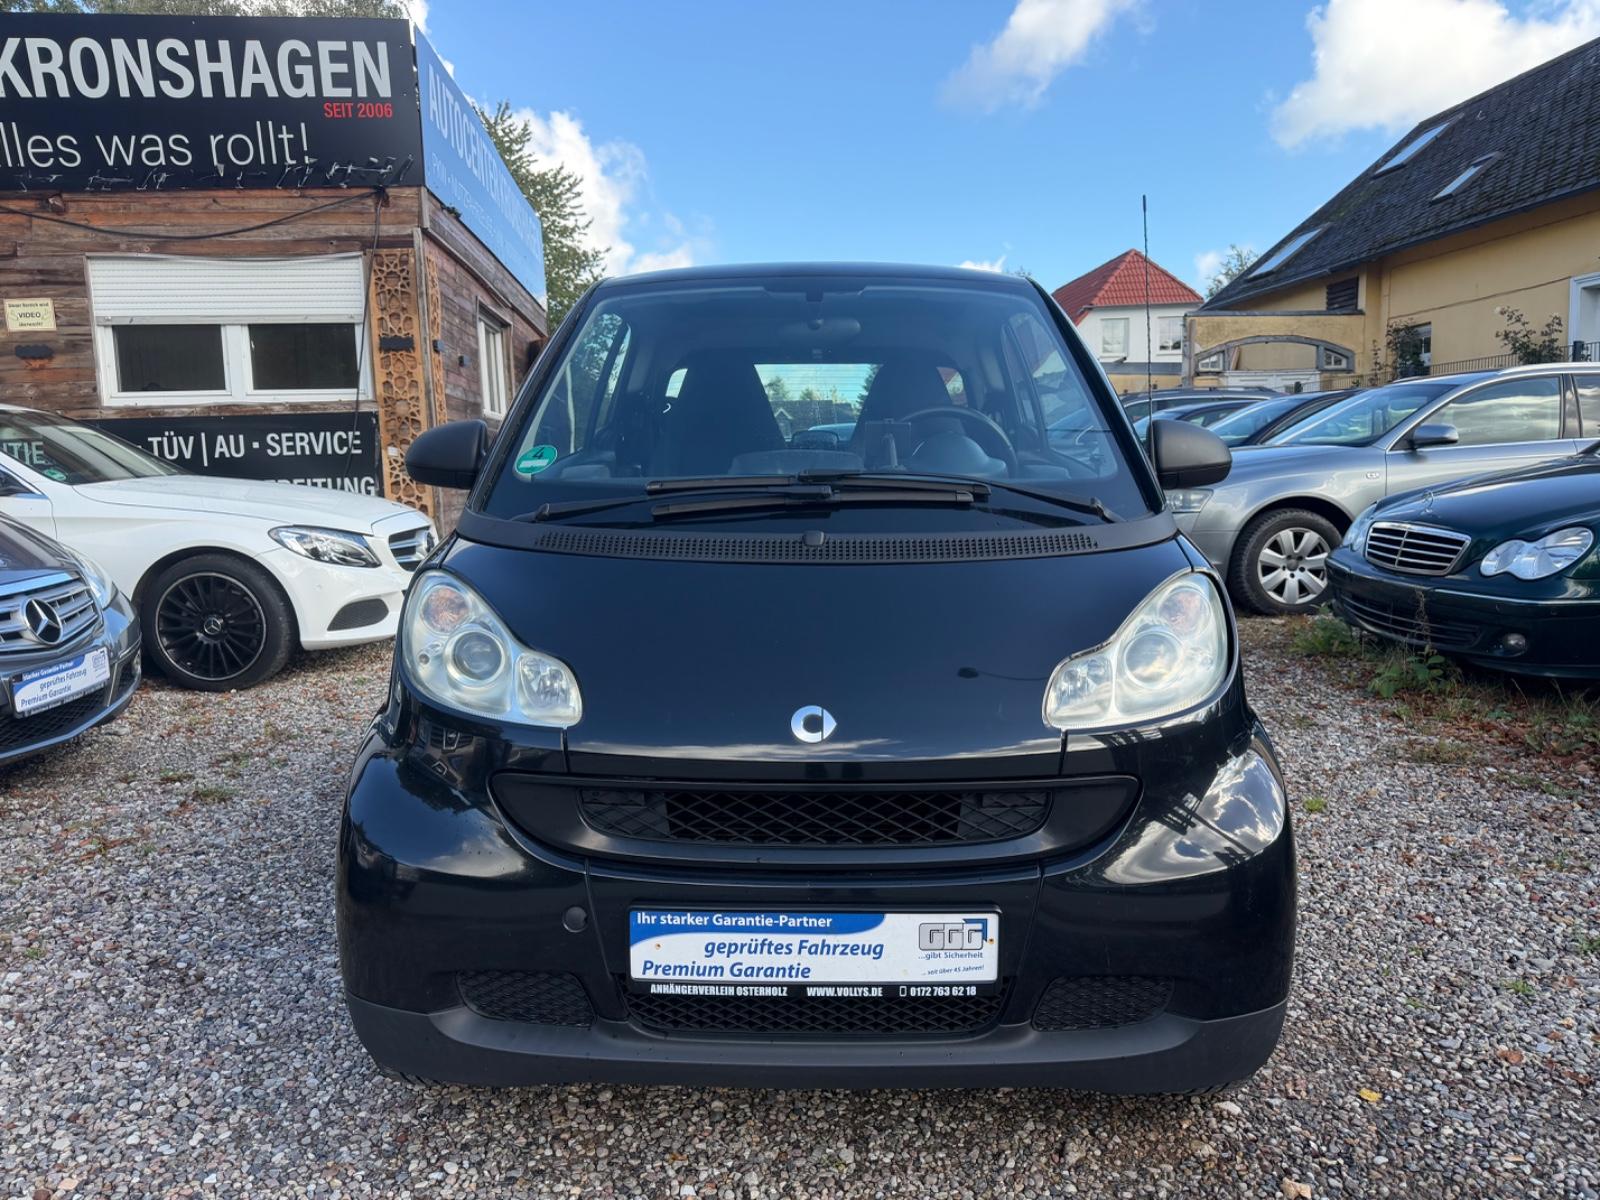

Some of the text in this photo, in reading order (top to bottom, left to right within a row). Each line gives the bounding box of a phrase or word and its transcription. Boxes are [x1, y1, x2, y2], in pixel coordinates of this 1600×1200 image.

[0, 37, 392, 99] KRONSHAGEN
[323, 102, 393, 118] SEIT 2006
[0, 120, 310, 169] lles was rollt!
[18, 311, 41, 319] VIDEO
[148, 431, 194, 460] TÜV
[214, 434, 246, 459] AU
[266, 430, 362, 457] SERVICE
[532, 447, 545, 459] 4
[20, 693, 48, 708] Premium
[637, 912, 832, 928] Ihr starker Garantie-Partner
[704, 938, 884, 960] geprüftes Fahrzeug
[944, 951, 984, 959] Sicherheit
[642, 960, 811, 979] Premium Garantie
[650, 983, 977, 997] ANHÄNGERVERLEIH OSTERHOLZ WWW.VOLLYS.DE 0172 763 62 18
